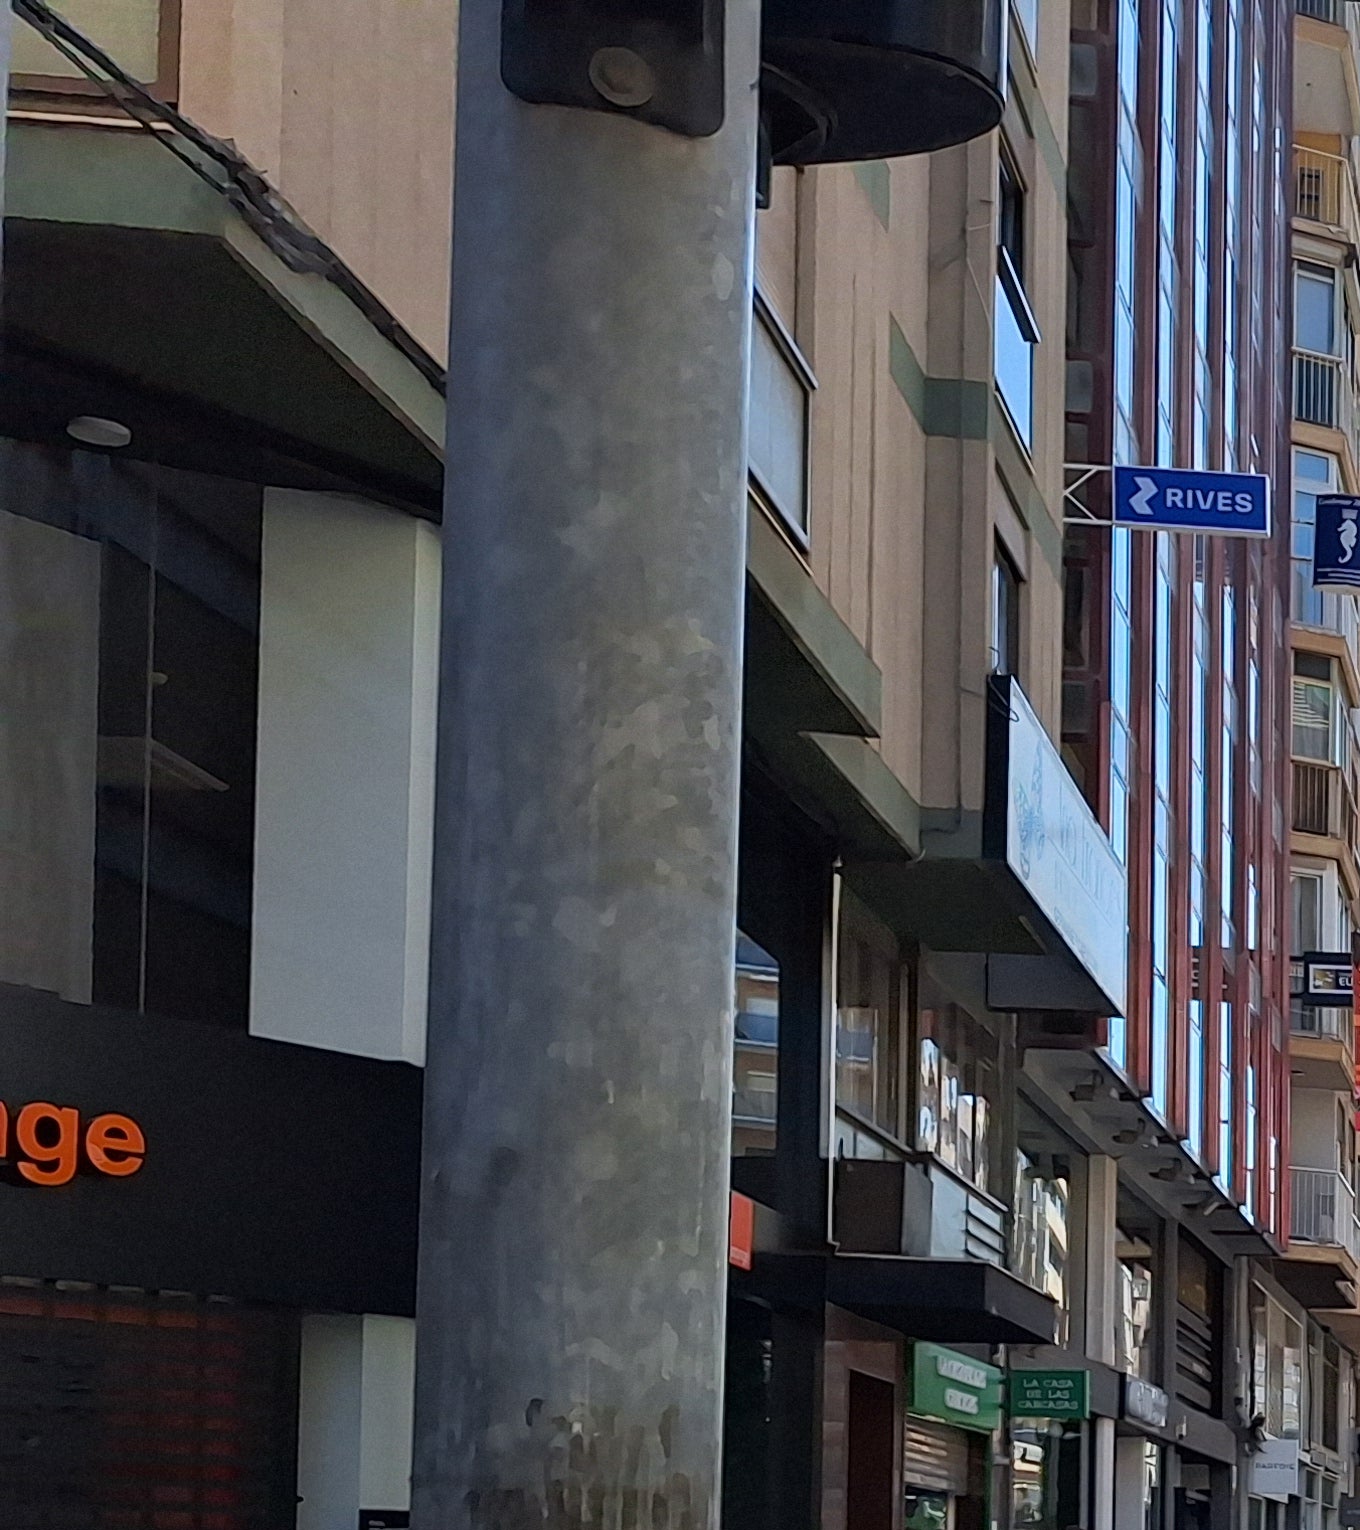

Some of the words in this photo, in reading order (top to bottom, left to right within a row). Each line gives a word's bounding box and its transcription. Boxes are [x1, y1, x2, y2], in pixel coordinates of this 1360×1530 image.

[1165, 487, 1254, 513] RIVES
[1023, 1379, 1040, 1388] LA
[1043, 1379, 1074, 1388] CASA
[1048, 1390, 1070, 1399] LAS
